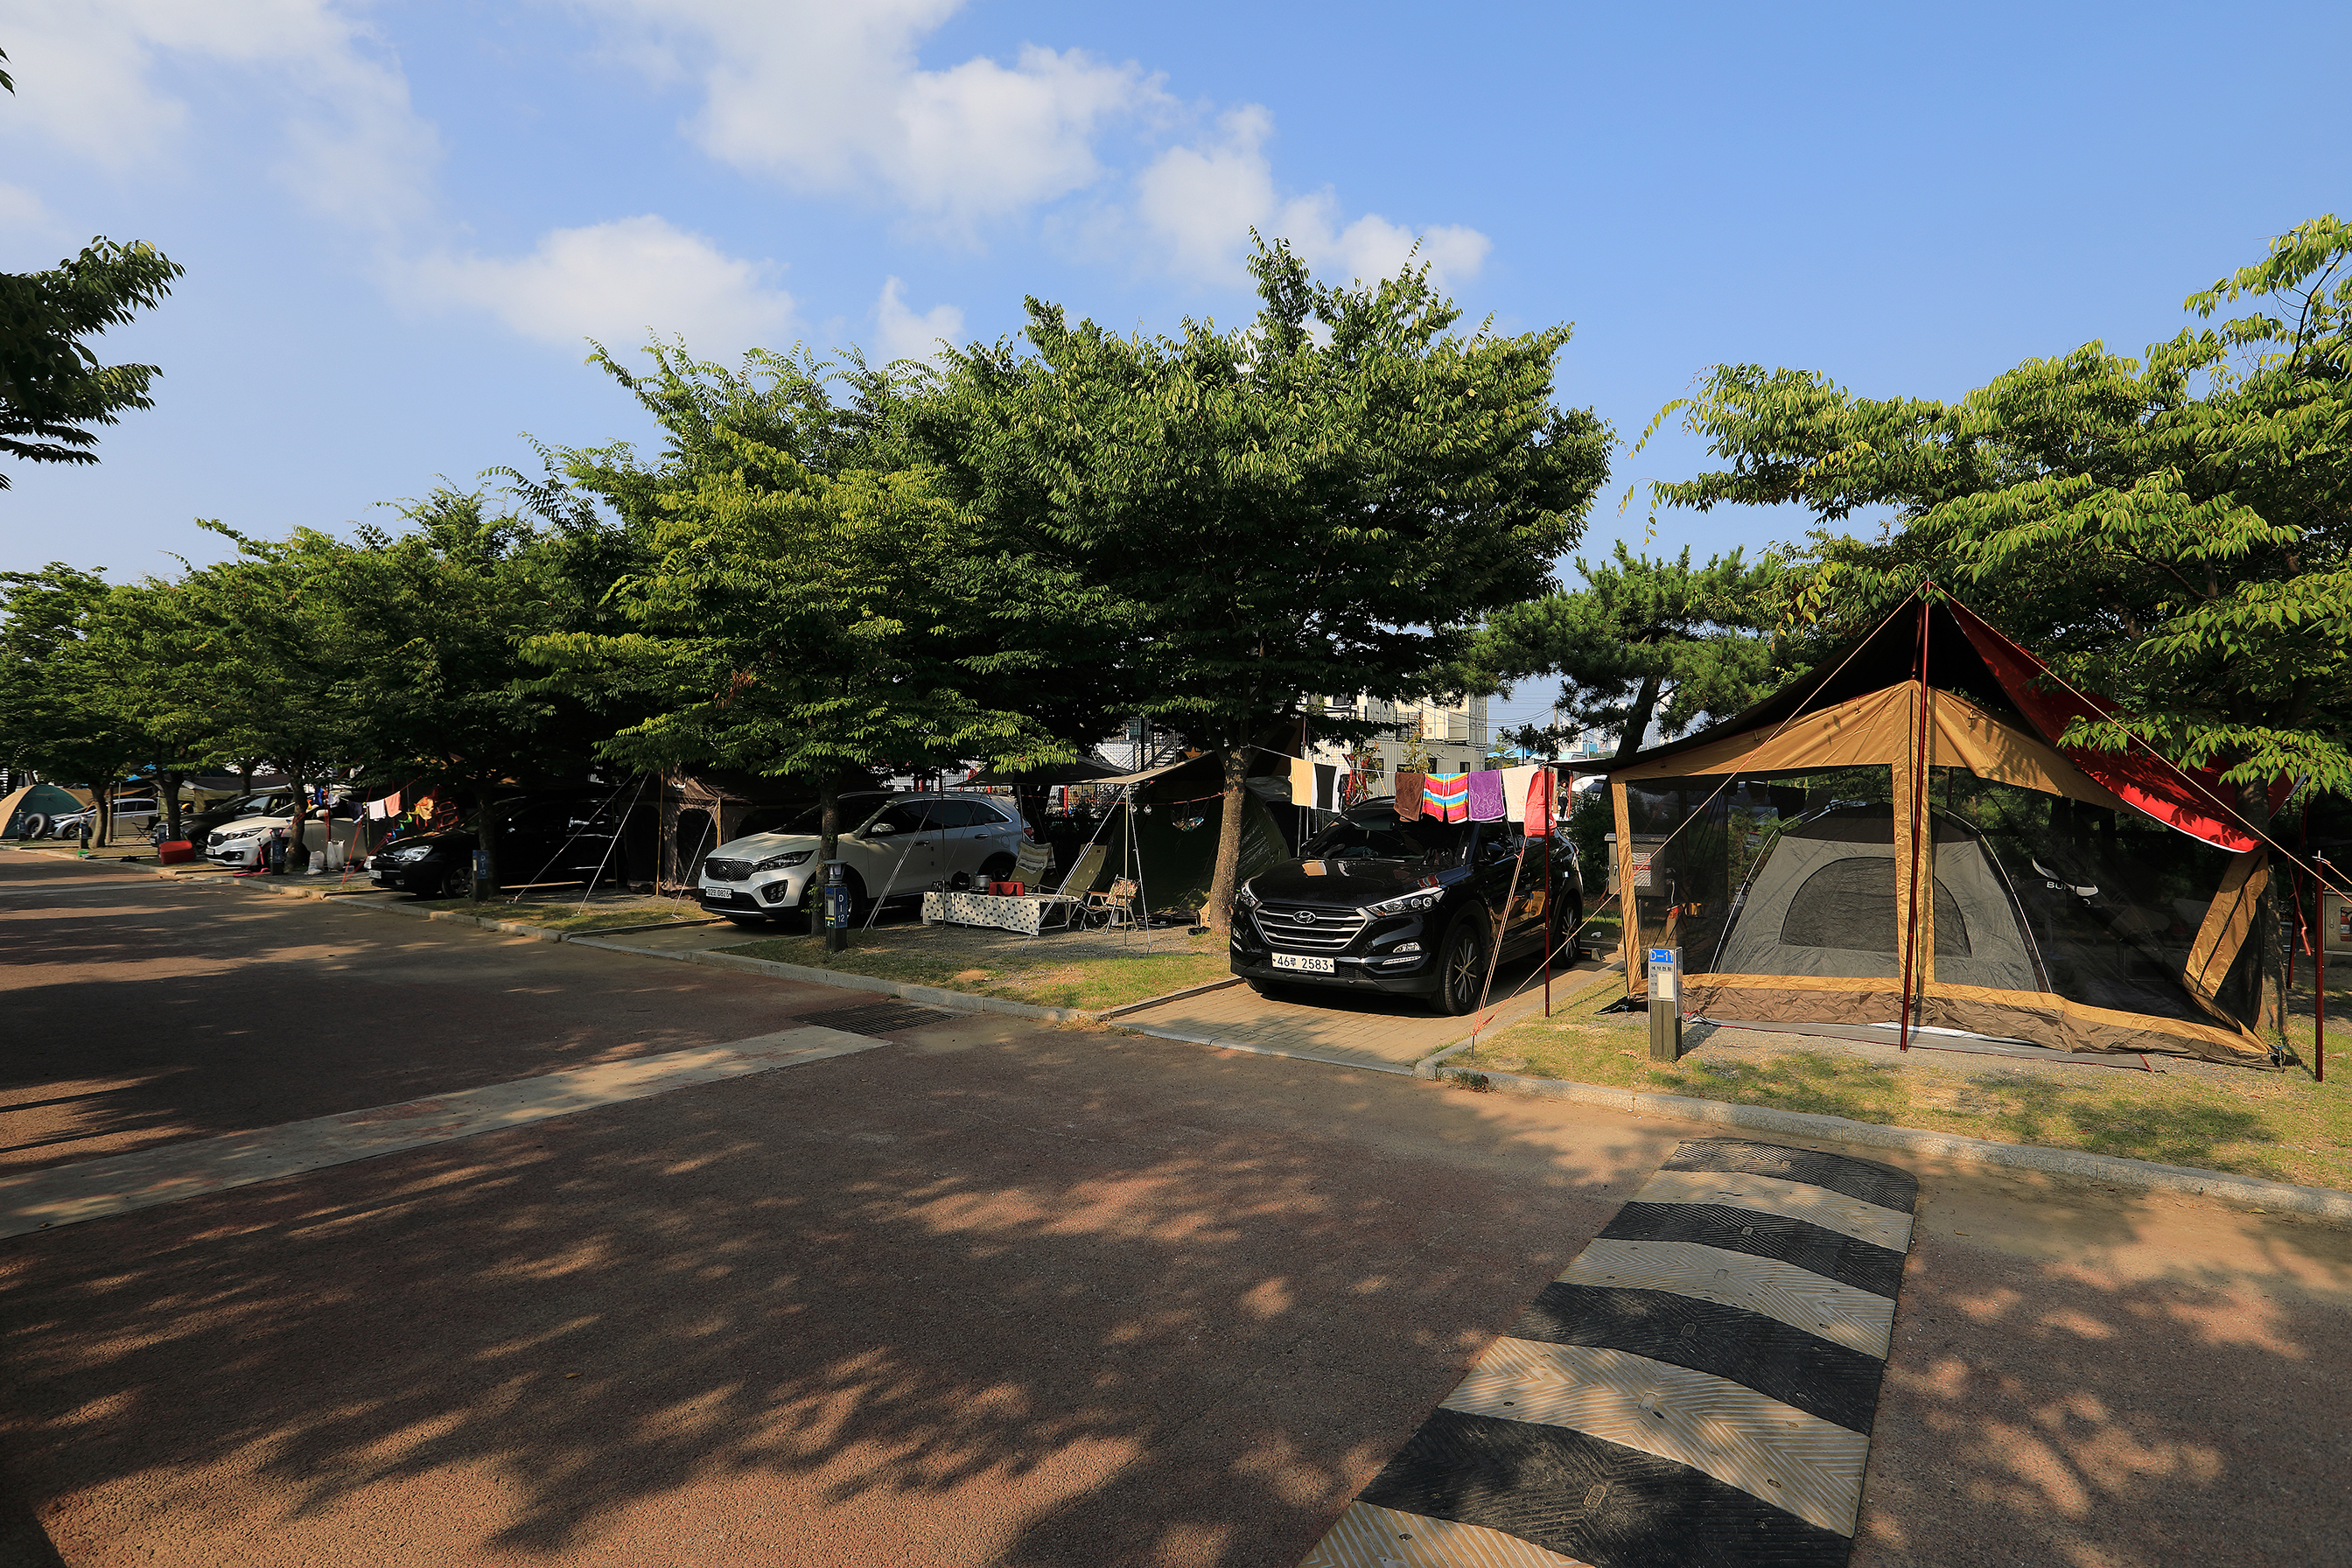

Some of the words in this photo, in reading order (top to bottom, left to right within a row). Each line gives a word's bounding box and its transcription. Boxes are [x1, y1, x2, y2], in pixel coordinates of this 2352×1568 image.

[1650, 950, 1673, 962] D-11
[1277, 956, 1297, 967] 46루
[1301, 957, 1328, 970] 2583
